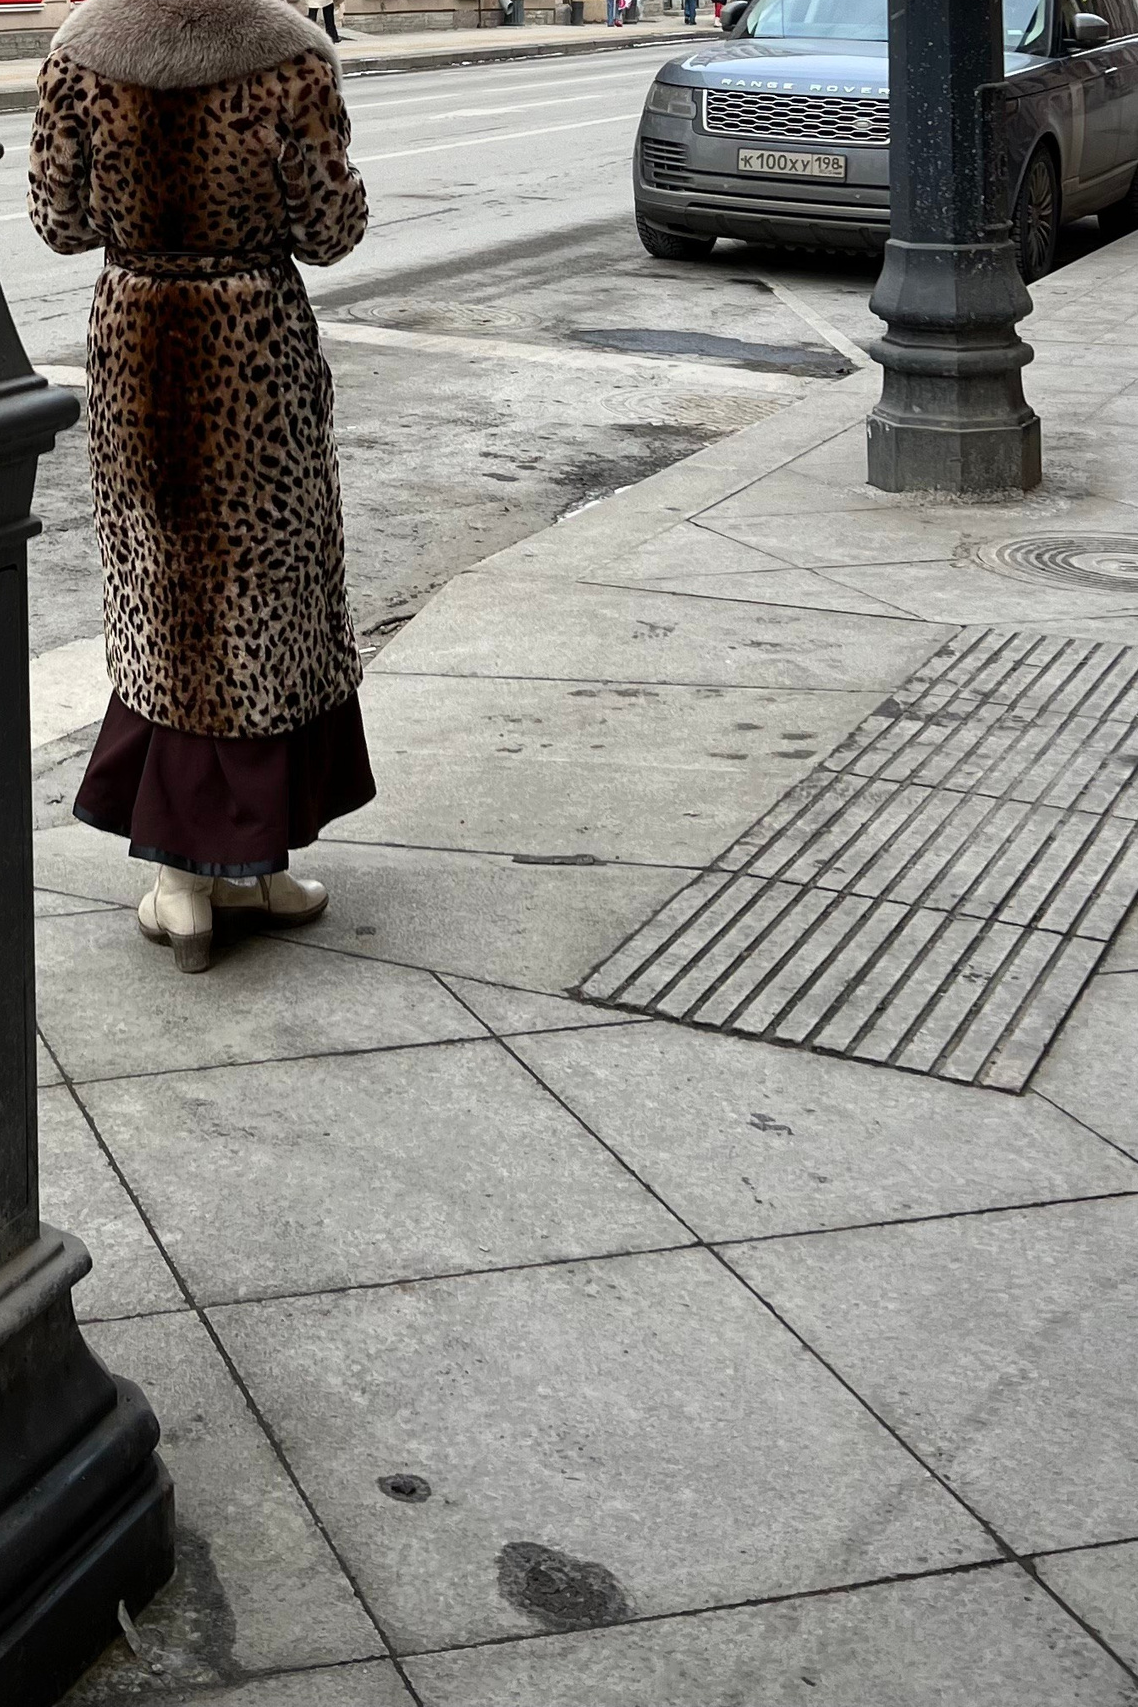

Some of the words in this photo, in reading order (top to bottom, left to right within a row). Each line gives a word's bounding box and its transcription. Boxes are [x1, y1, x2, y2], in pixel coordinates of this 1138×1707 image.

[721, 78, 796, 90] RANGE
[809, 83, 890, 95] ROVER
[814, 156, 841, 170] 198
